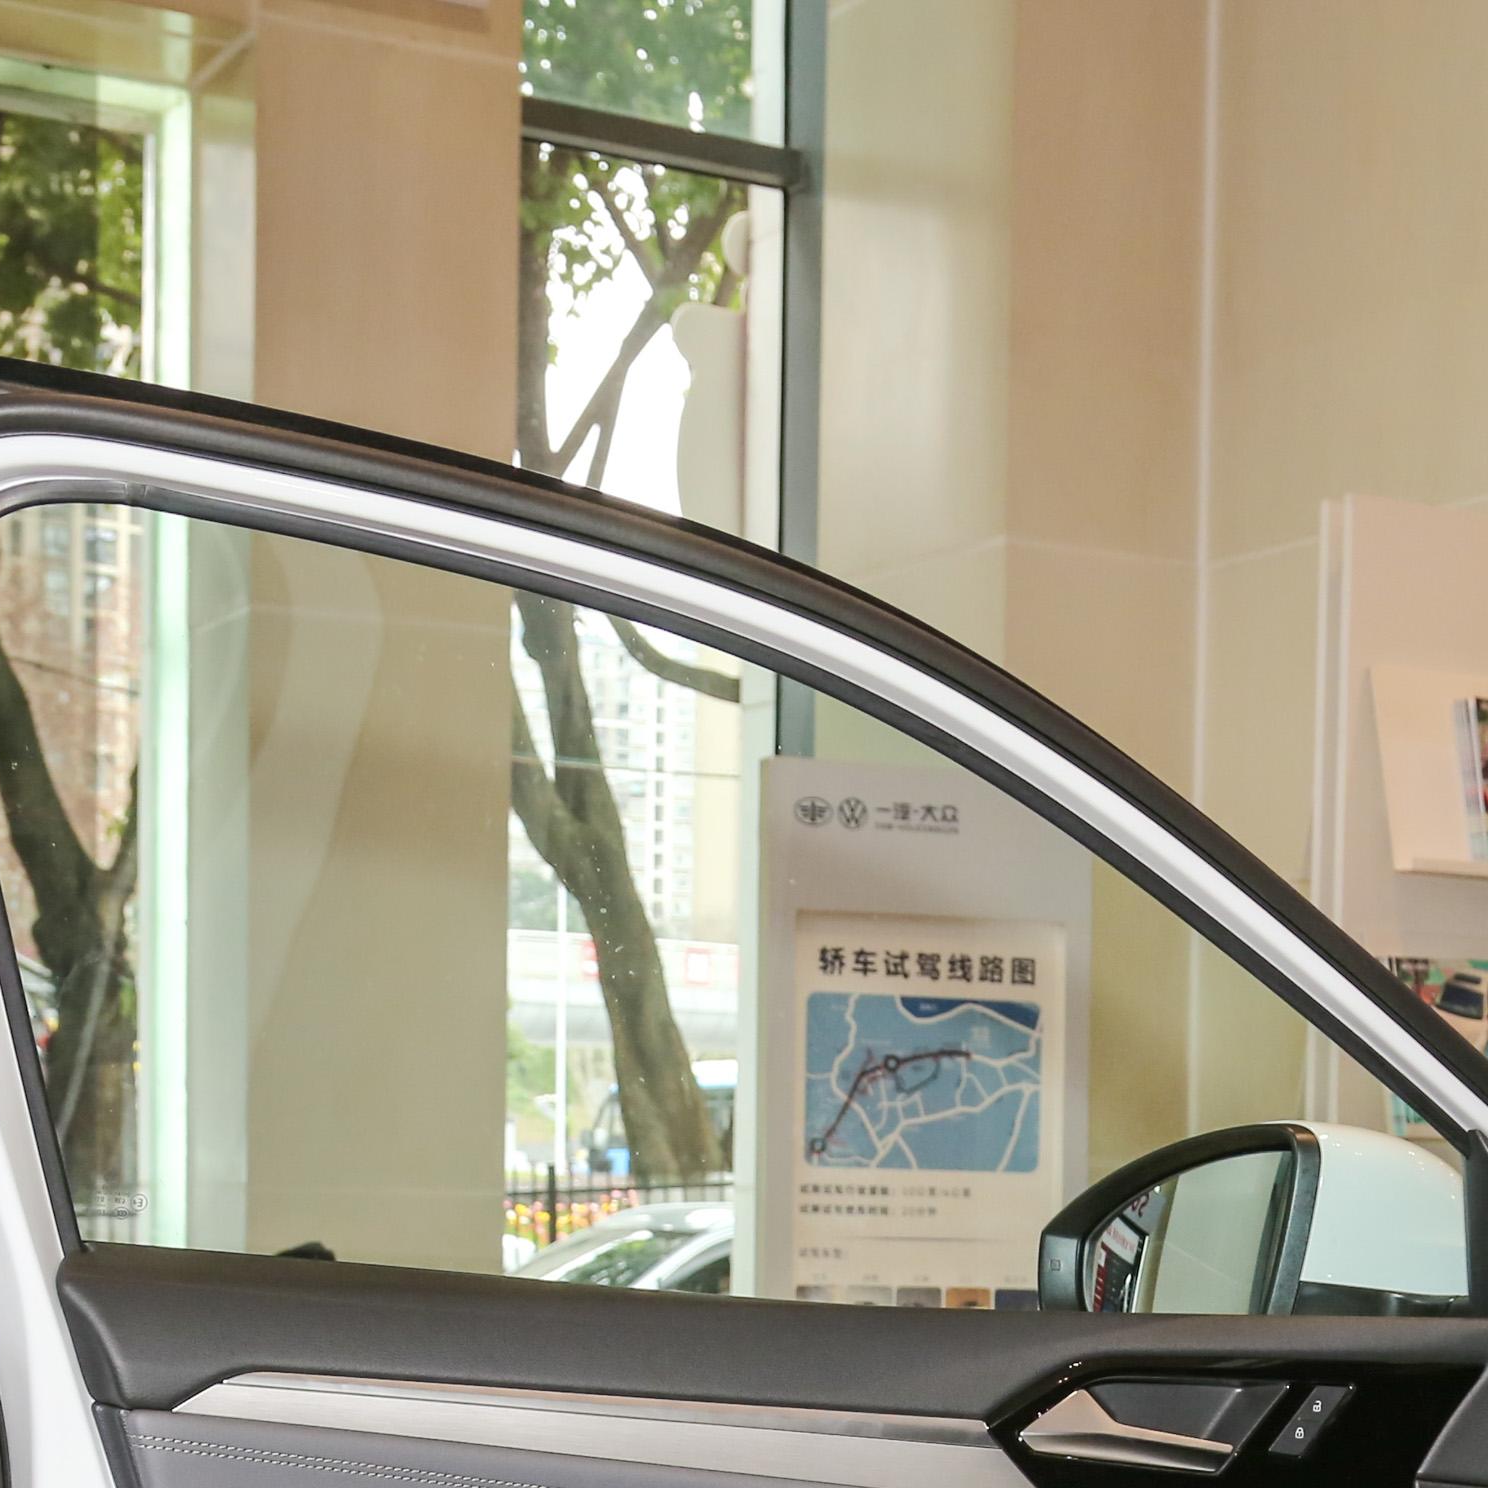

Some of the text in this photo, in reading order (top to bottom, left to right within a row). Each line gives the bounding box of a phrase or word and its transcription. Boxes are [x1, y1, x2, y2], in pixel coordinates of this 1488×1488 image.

[818, 946, 1036, 986] 轿车试驾线路图
